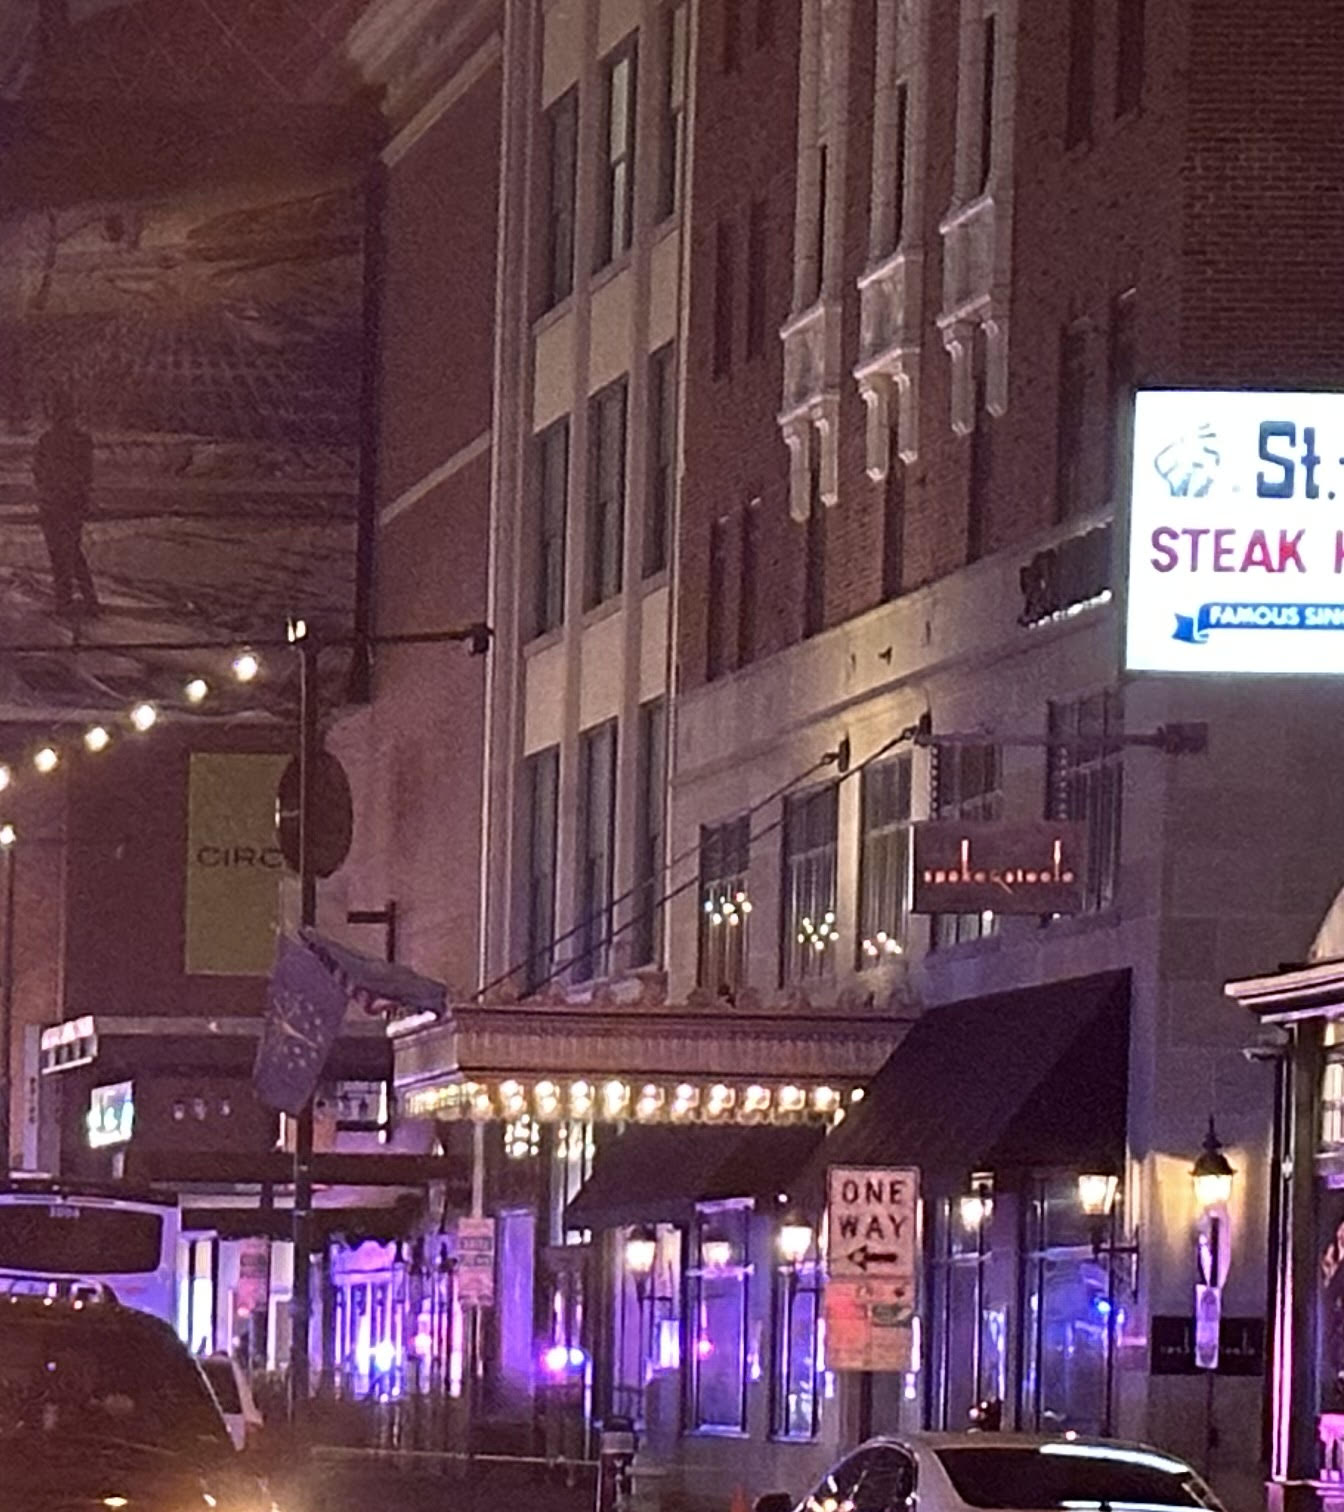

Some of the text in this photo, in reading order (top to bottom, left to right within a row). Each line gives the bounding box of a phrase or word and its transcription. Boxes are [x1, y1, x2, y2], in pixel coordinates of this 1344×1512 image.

[1256, 420, 1336, 500] St.
[1150, 526, 1307, 574] STEAK
[1209, 605, 1301, 626] FAMOUS
[842, 1180, 908, 1205] ONE
[839, 1215, 909, 1239] WAY
